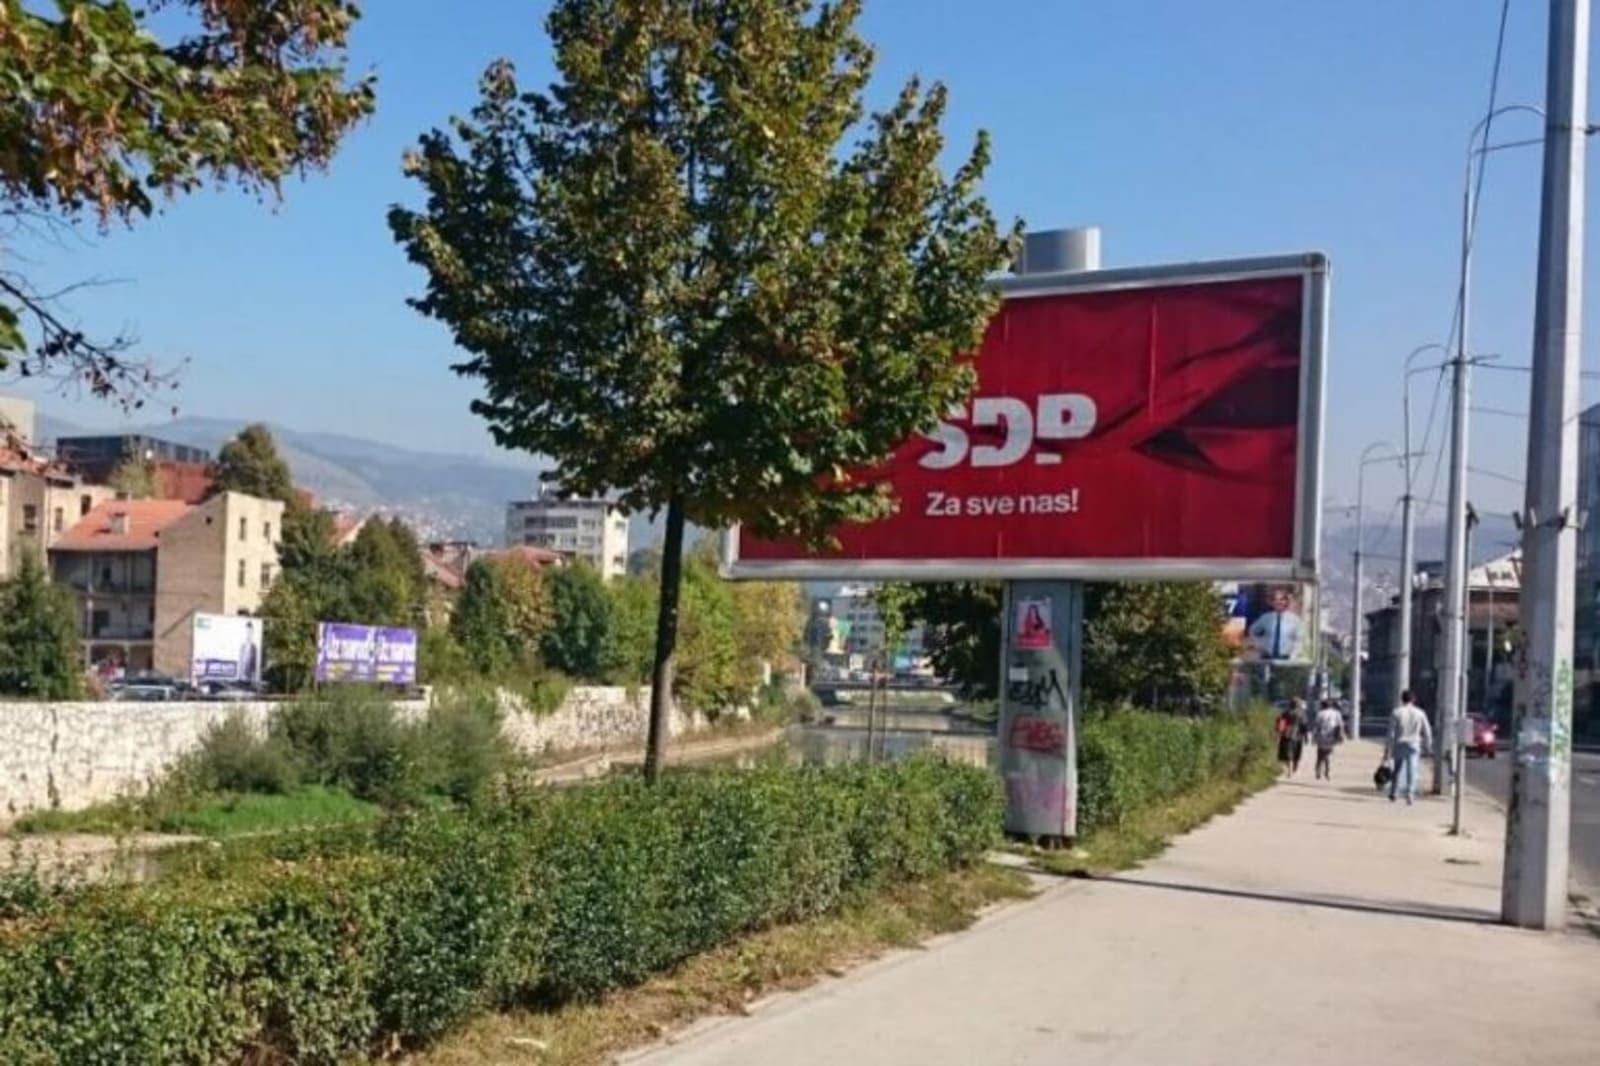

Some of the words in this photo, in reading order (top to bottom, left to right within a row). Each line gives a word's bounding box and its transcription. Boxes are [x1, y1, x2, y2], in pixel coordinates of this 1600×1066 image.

[918, 393, 1098, 470] SDP
[925, 492, 961, 517] Za
[966, 495, 1014, 516] sve
[1019, 488, 1080, 514] nas!
